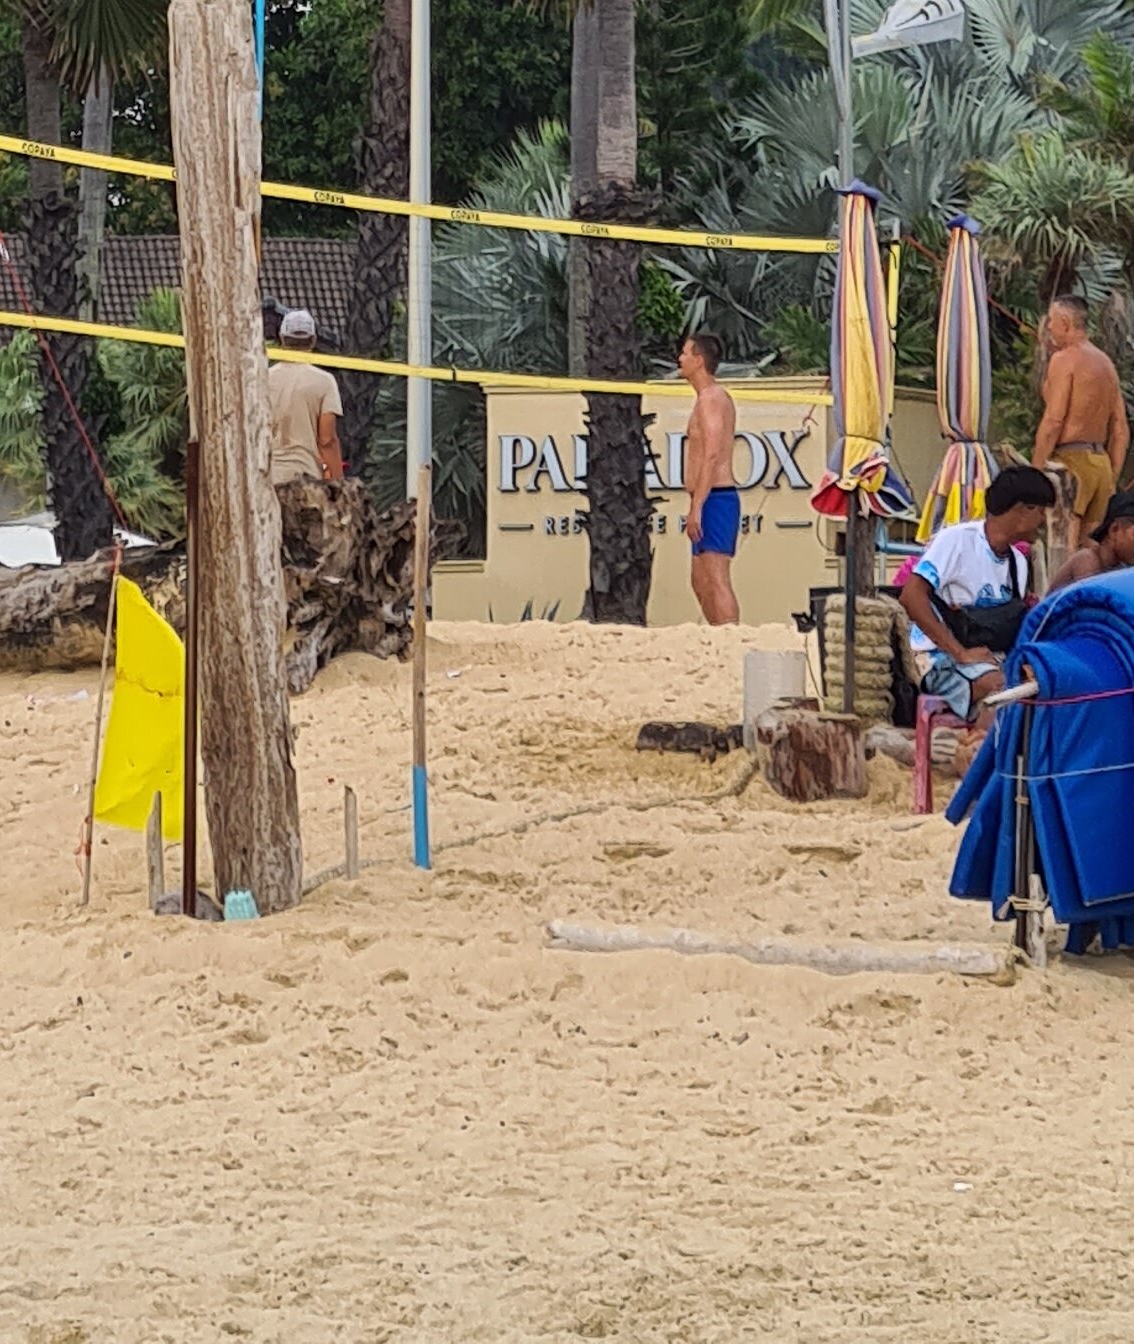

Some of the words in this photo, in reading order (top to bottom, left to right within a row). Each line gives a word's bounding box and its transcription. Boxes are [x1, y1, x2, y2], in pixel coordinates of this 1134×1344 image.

[22, 142, 55, 157] COPAYA
[314, 191, 345, 204] COPAYA
[451, 210, 480, 222] COPAYA
[581, 224, 610, 235] COPAYA
